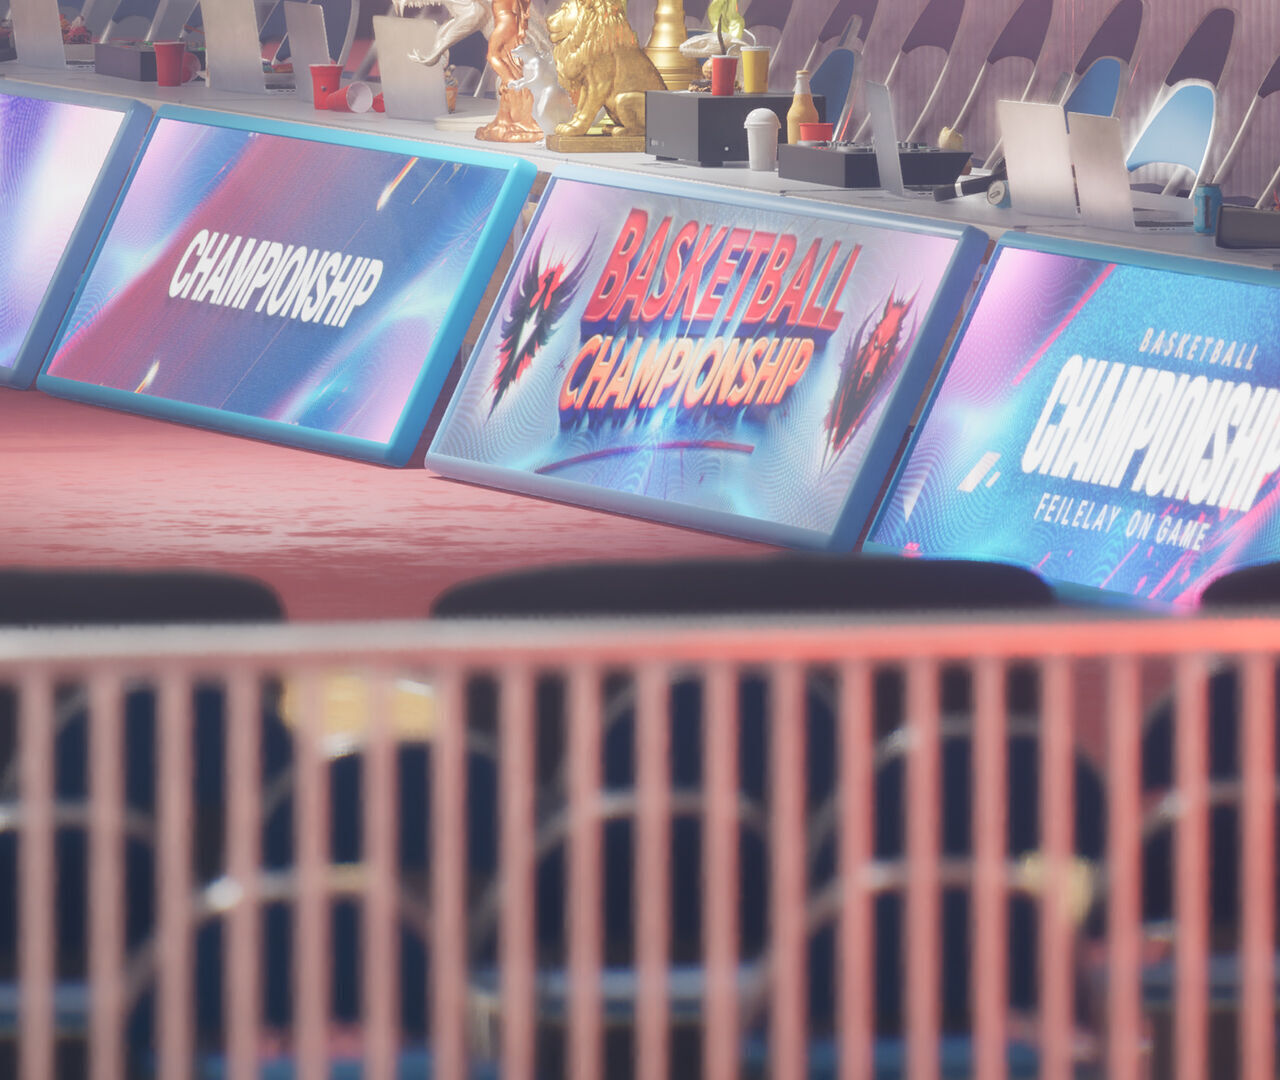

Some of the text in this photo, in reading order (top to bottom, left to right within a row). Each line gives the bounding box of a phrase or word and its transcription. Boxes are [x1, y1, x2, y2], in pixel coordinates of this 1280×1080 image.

[169, 229, 384, 328] CHAMPIONSHIP
[583, 207, 863, 331] BASKETBALL
[558, 334, 815, 412] CHAMPIONSHIP
[1138, 327, 1259, 371] BASKETBALL
[1033, 492, 1211, 552] FEILELAY ON GAME
